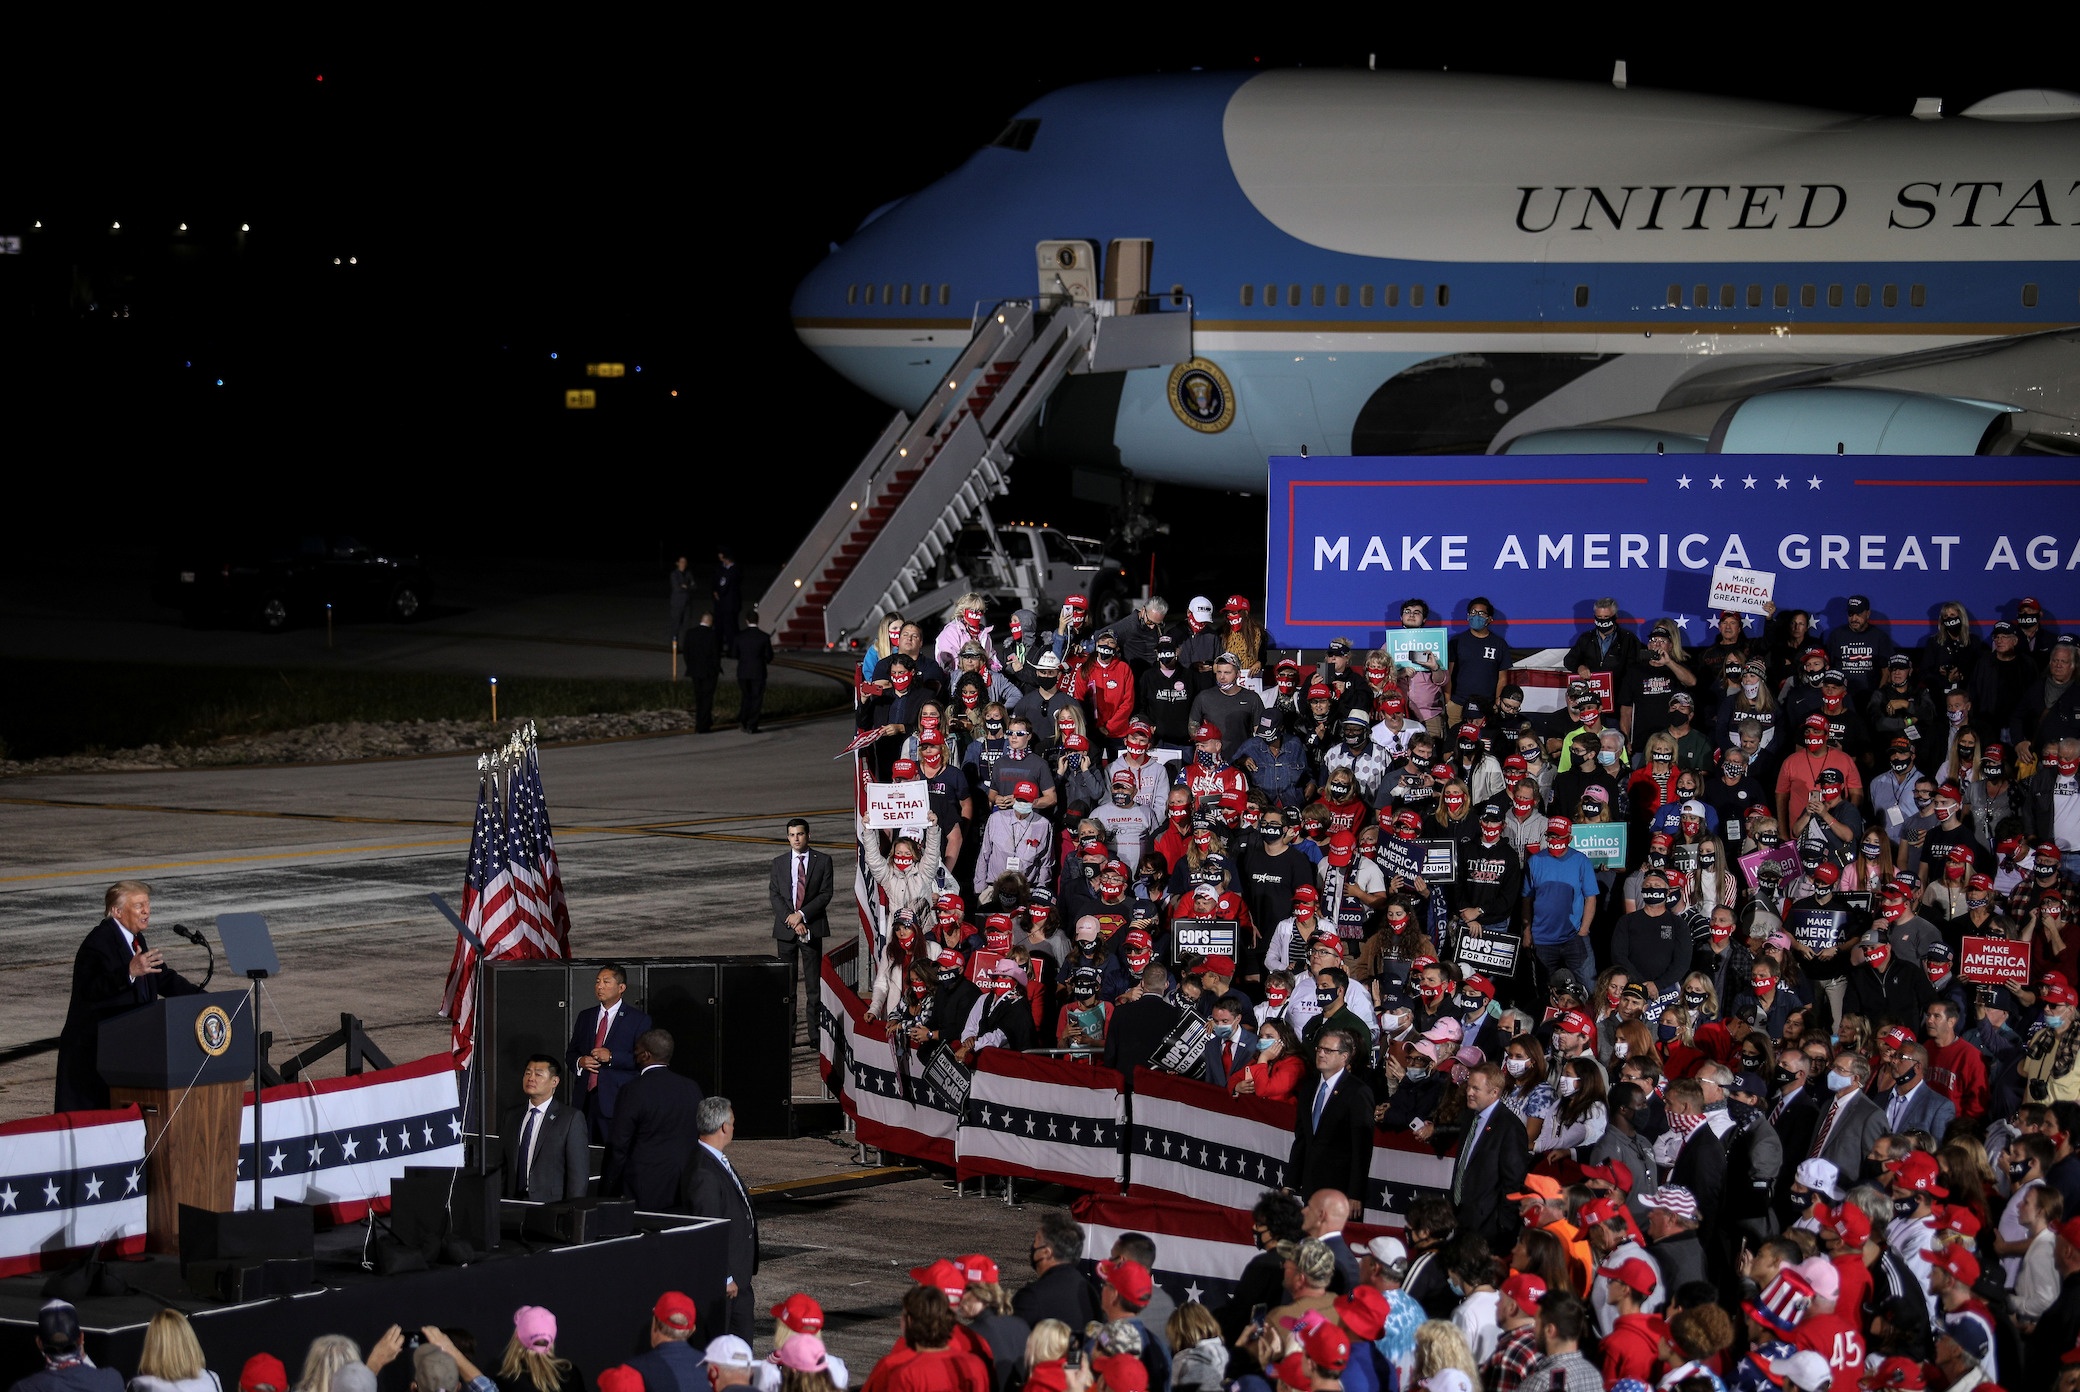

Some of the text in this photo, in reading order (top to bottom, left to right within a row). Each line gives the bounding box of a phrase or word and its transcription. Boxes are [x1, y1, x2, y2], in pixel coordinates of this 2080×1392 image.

[1516, 178, 2080, 232] UNITED STA
[1314, 536, 1468, 570] MAKE
[1494, 534, 1752, 571] AMERICA
[1778, 534, 1960, 569] GREAT
[1732, 576, 1756, 584] MAKE
[1716, 582, 1768, 598] AMERICA
[1714, 594, 1768, 606] GREAT AGAIN
[1394, 639, 1440, 651] Latinos
[1840, 645, 1872, 656] Trump
[1483, 646, 1496, 660] H
[1128, 746, 1146, 754] MAGA
[872, 800, 924, 810] FILL THAT
[884, 810, 914, 820] SEAT!
[1388, 840, 1408, 855] MAKE
[1574, 835, 1619, 847] Latinos
[1378, 845, 1418, 874] AMERICA
[1467, 858, 1506, 874] Trump
[1376, 856, 1418, 883] GREAT AGAIN
[1339, 914, 1361, 922] 2020
[1806, 917, 1832, 926] MAKE
[1178, 930, 1210, 944] COPS
[1794, 928, 1846, 940] AMERICA
[1461, 936, 1492, 954] COPS
[1982, 945, 2010, 954] MAKE
[1462, 952, 1511, 966] FOR TRUMP
[1964, 954, 2026, 968] AMERICA
[1964, 966, 2026, 977] GREAT AGAIN
[1190, 1033, 1212, 1060] TRUMP
[1161, 1042, 1190, 1068] COPS
[938, 1056, 968, 1092] FOR TRUMP
[944, 1078, 963, 1104] COPS
[1813, 1180, 1824, 1188] 45
[1916, 1178, 1926, 1188] 45
[1791, 1195, 1804, 1205] GA
[1894, 1202, 1911, 1211] GA
[1830, 1331, 1862, 1370] 45
